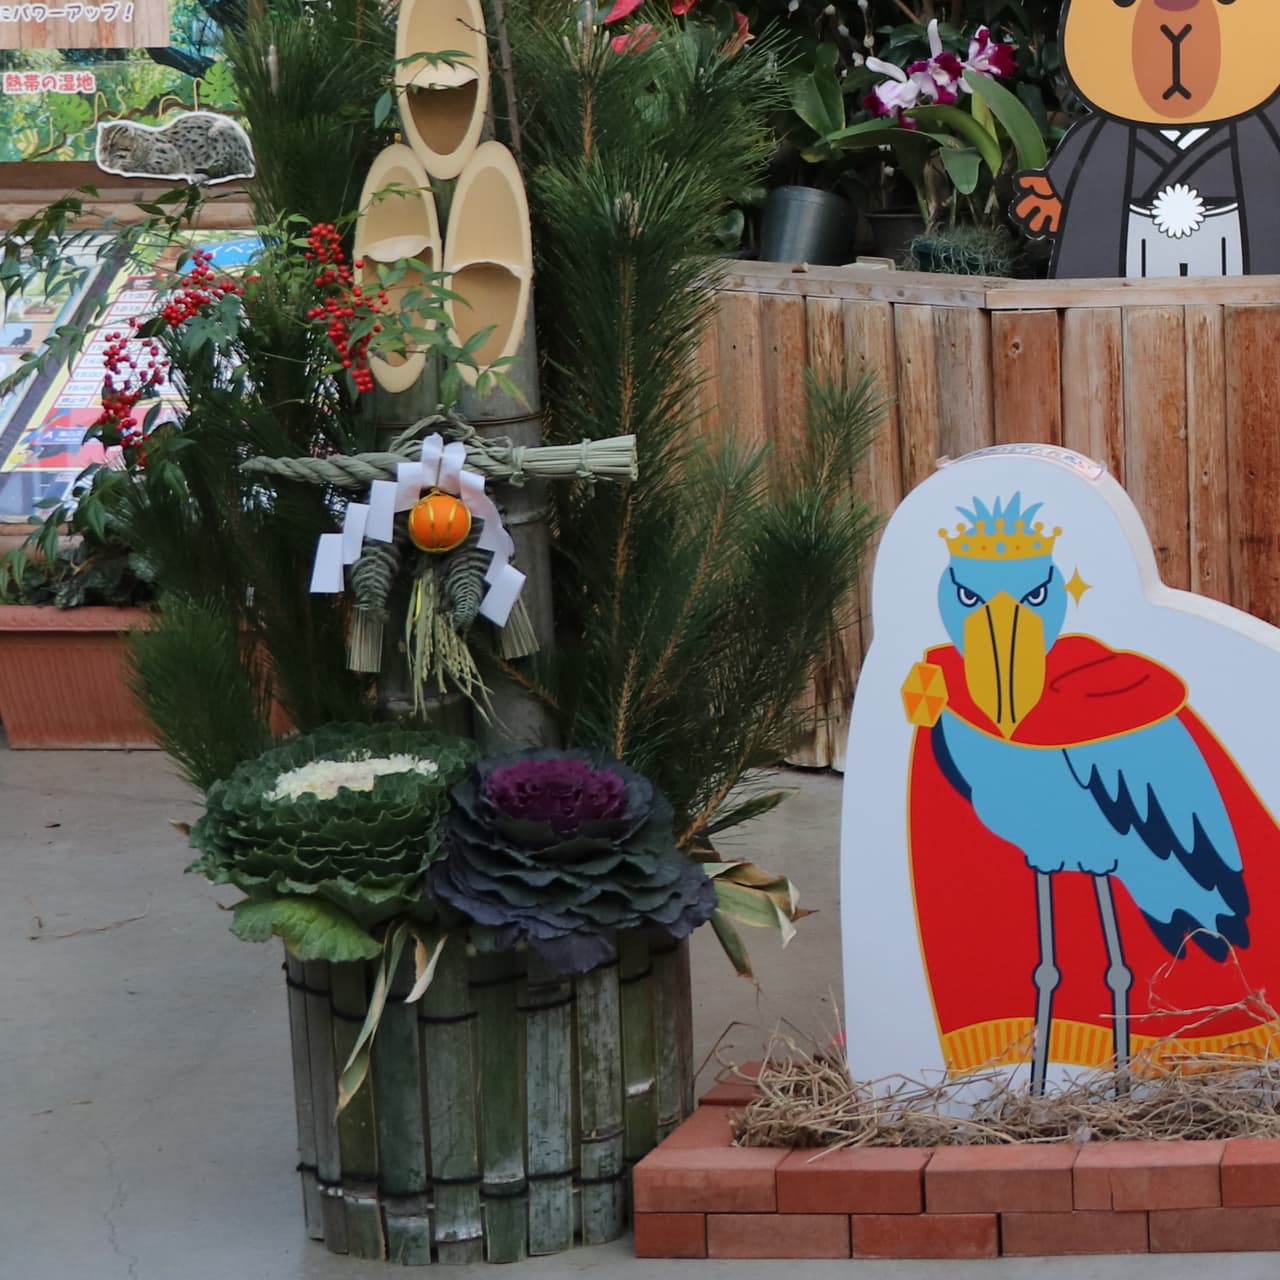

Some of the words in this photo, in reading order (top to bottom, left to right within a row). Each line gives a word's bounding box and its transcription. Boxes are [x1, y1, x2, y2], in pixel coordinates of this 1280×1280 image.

[4, 73, 95, 93] 熱帯の湿地
